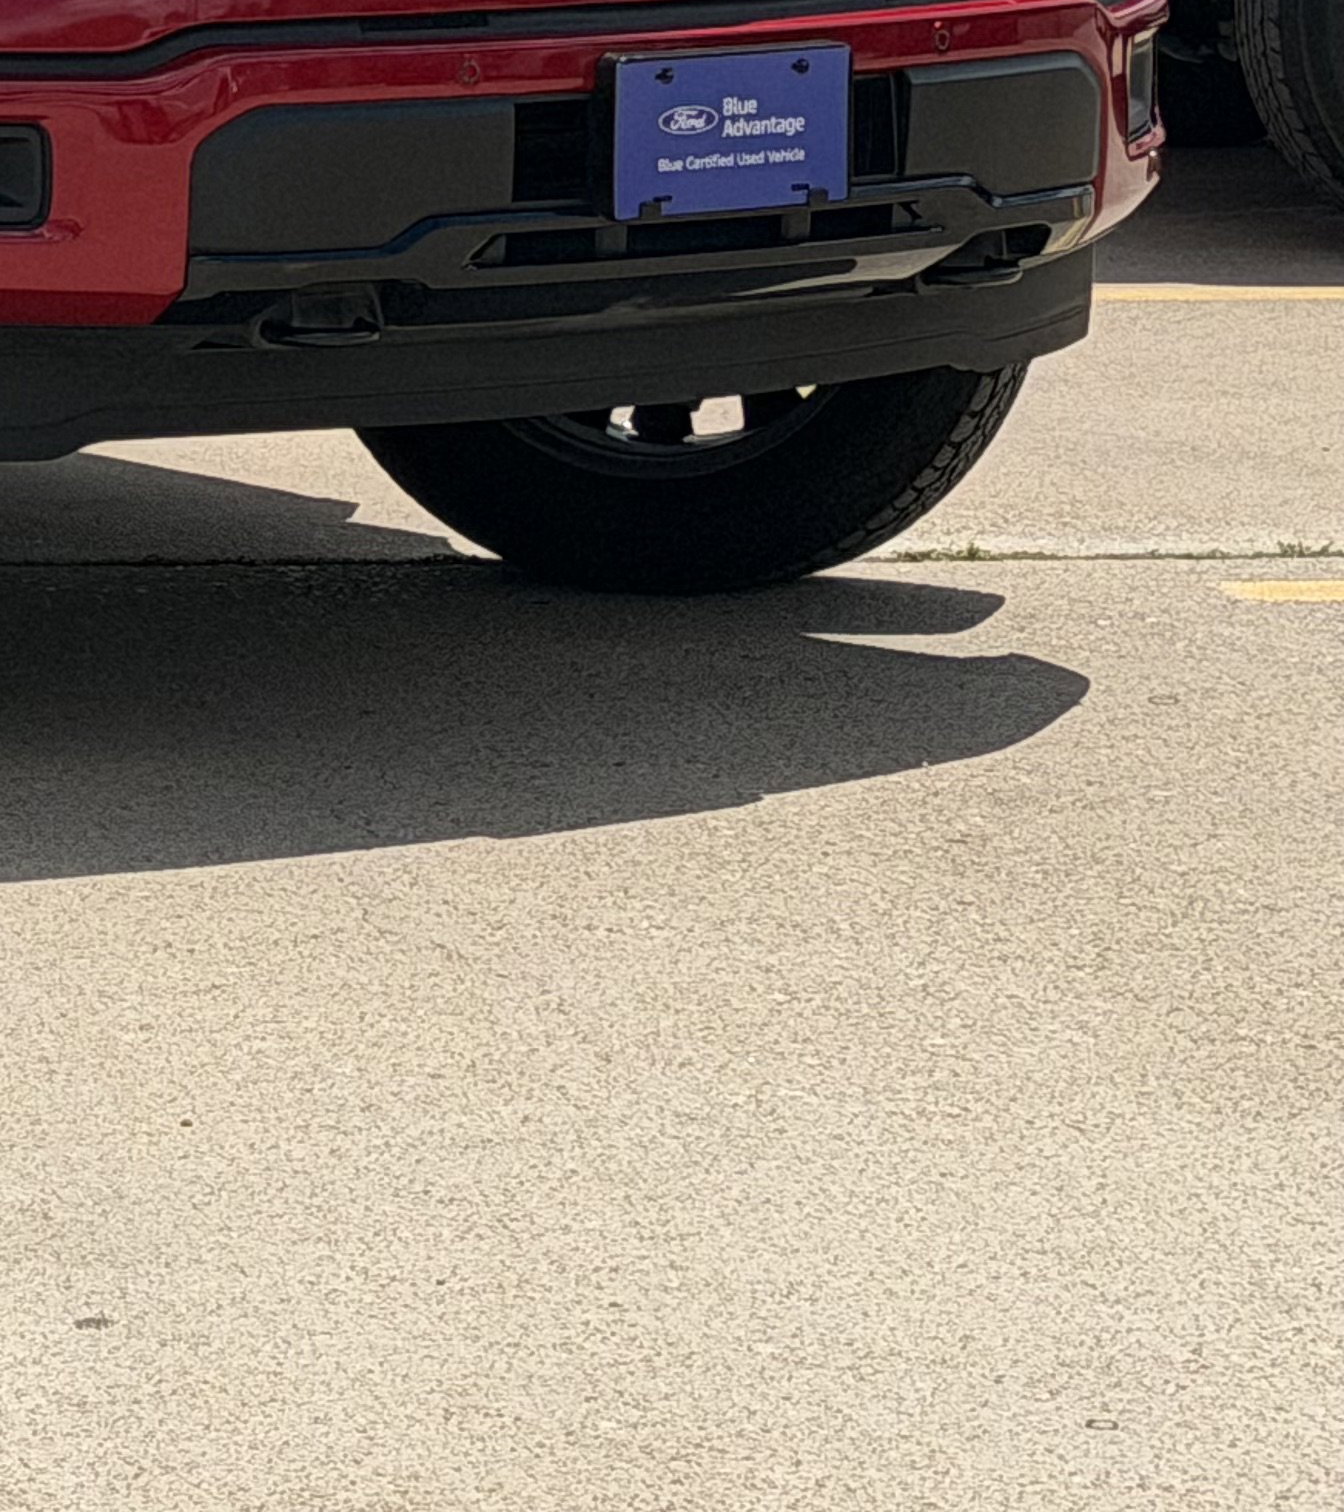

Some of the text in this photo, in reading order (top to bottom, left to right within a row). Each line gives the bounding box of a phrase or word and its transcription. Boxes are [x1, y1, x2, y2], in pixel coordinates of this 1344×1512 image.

[669, 96, 758, 130] Ford Blue
[721, 116, 806, 138] Advantage
[657, 146, 806, 173] Blue Certified Used Vehicle
